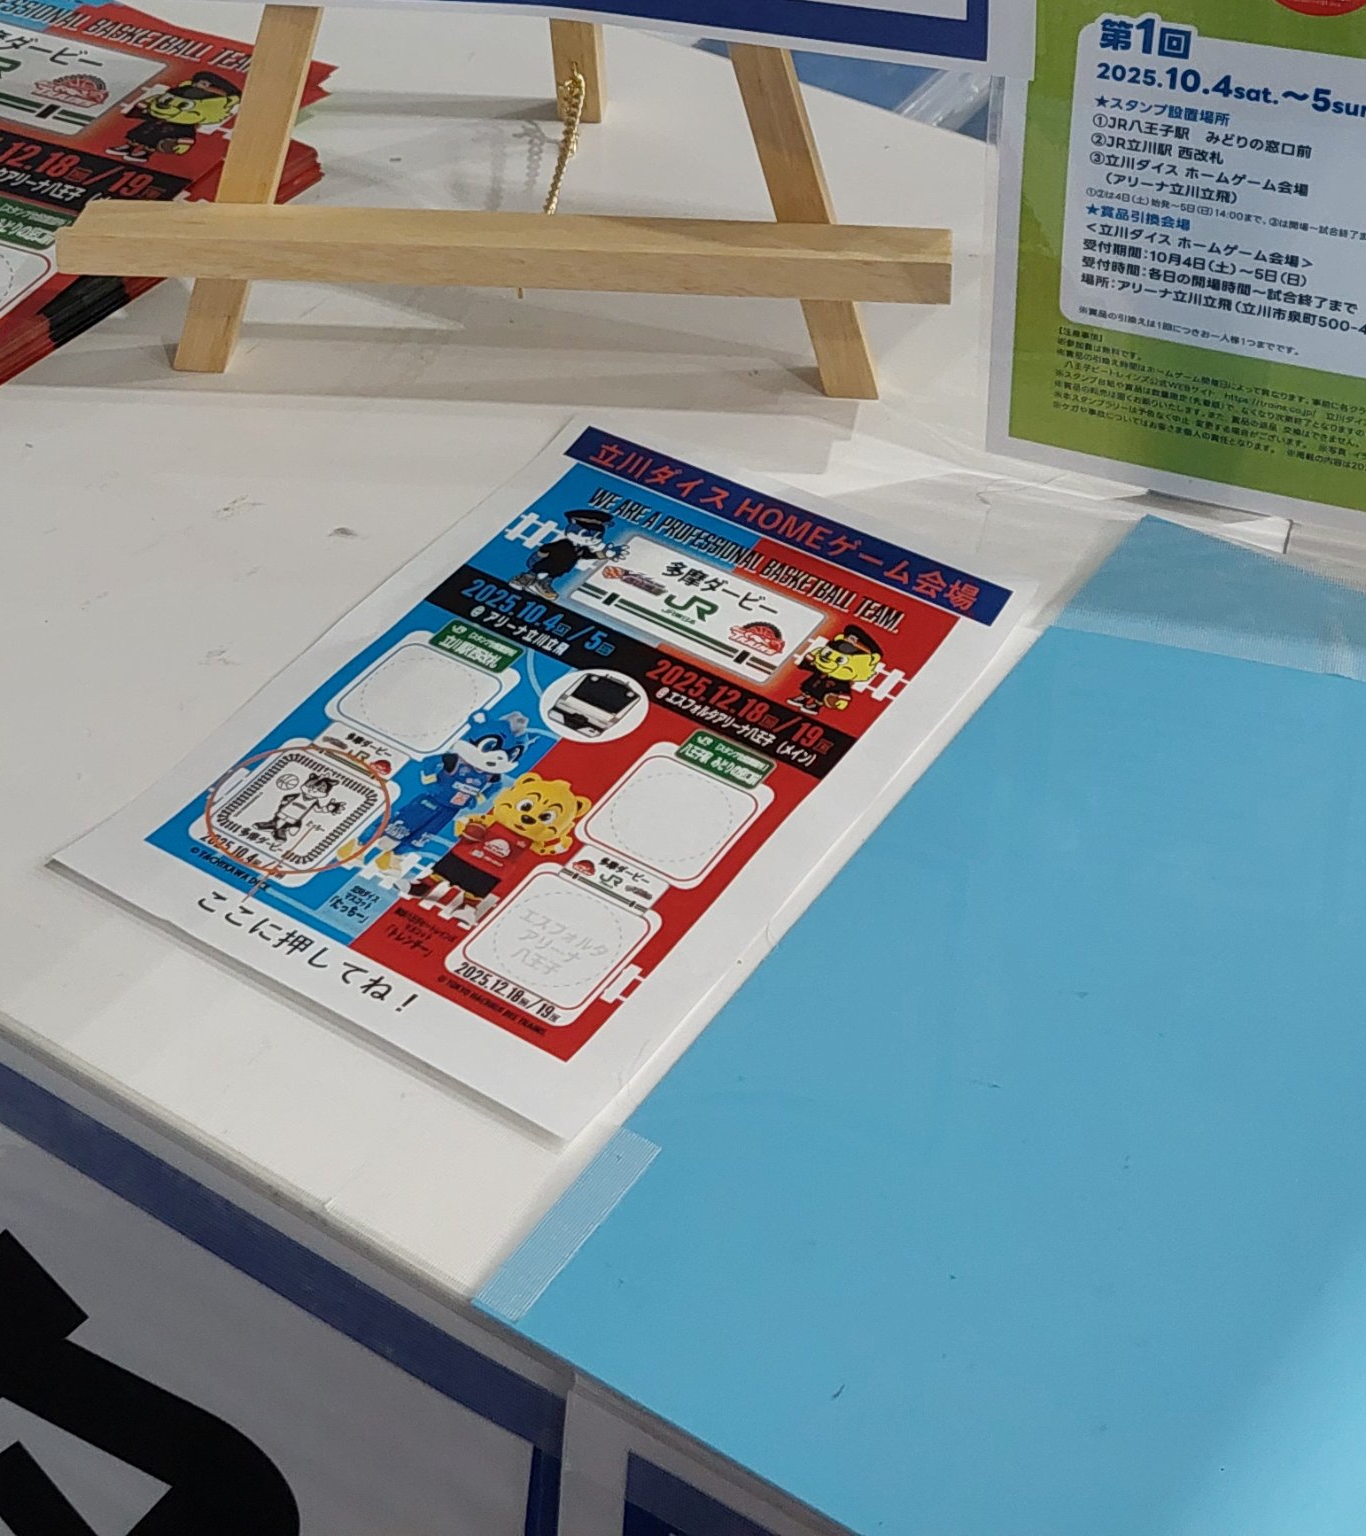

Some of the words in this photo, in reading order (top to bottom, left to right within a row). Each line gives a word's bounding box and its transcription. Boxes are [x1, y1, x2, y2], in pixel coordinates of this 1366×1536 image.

[1099, 17, 1194, 61] 第1回
[1177, 145, 1225, 166] 西改札
[1205, 130, 1313, 160] みどりの窓口前
[1184, 165, 1310, 198] ホームゲーム会場
[587, 486, 620, 512] WE
[612, 497, 655, 529] ARE
[588, 441, 724, 511] 立川ダイス
[733, 497, 983, 614] HOMEゲーム会場
[662, 560, 779, 615] 多摩ダービー
[662, 594, 719, 623] JR
[599, 872, 624, 889] JR
[518, 907, 609, 958] エスフォルタ
[518, 928, 582, 965] アリーナ
[196, 890, 420, 1013] ここに押してね！
[510, 947, 564, 976] 八王子
